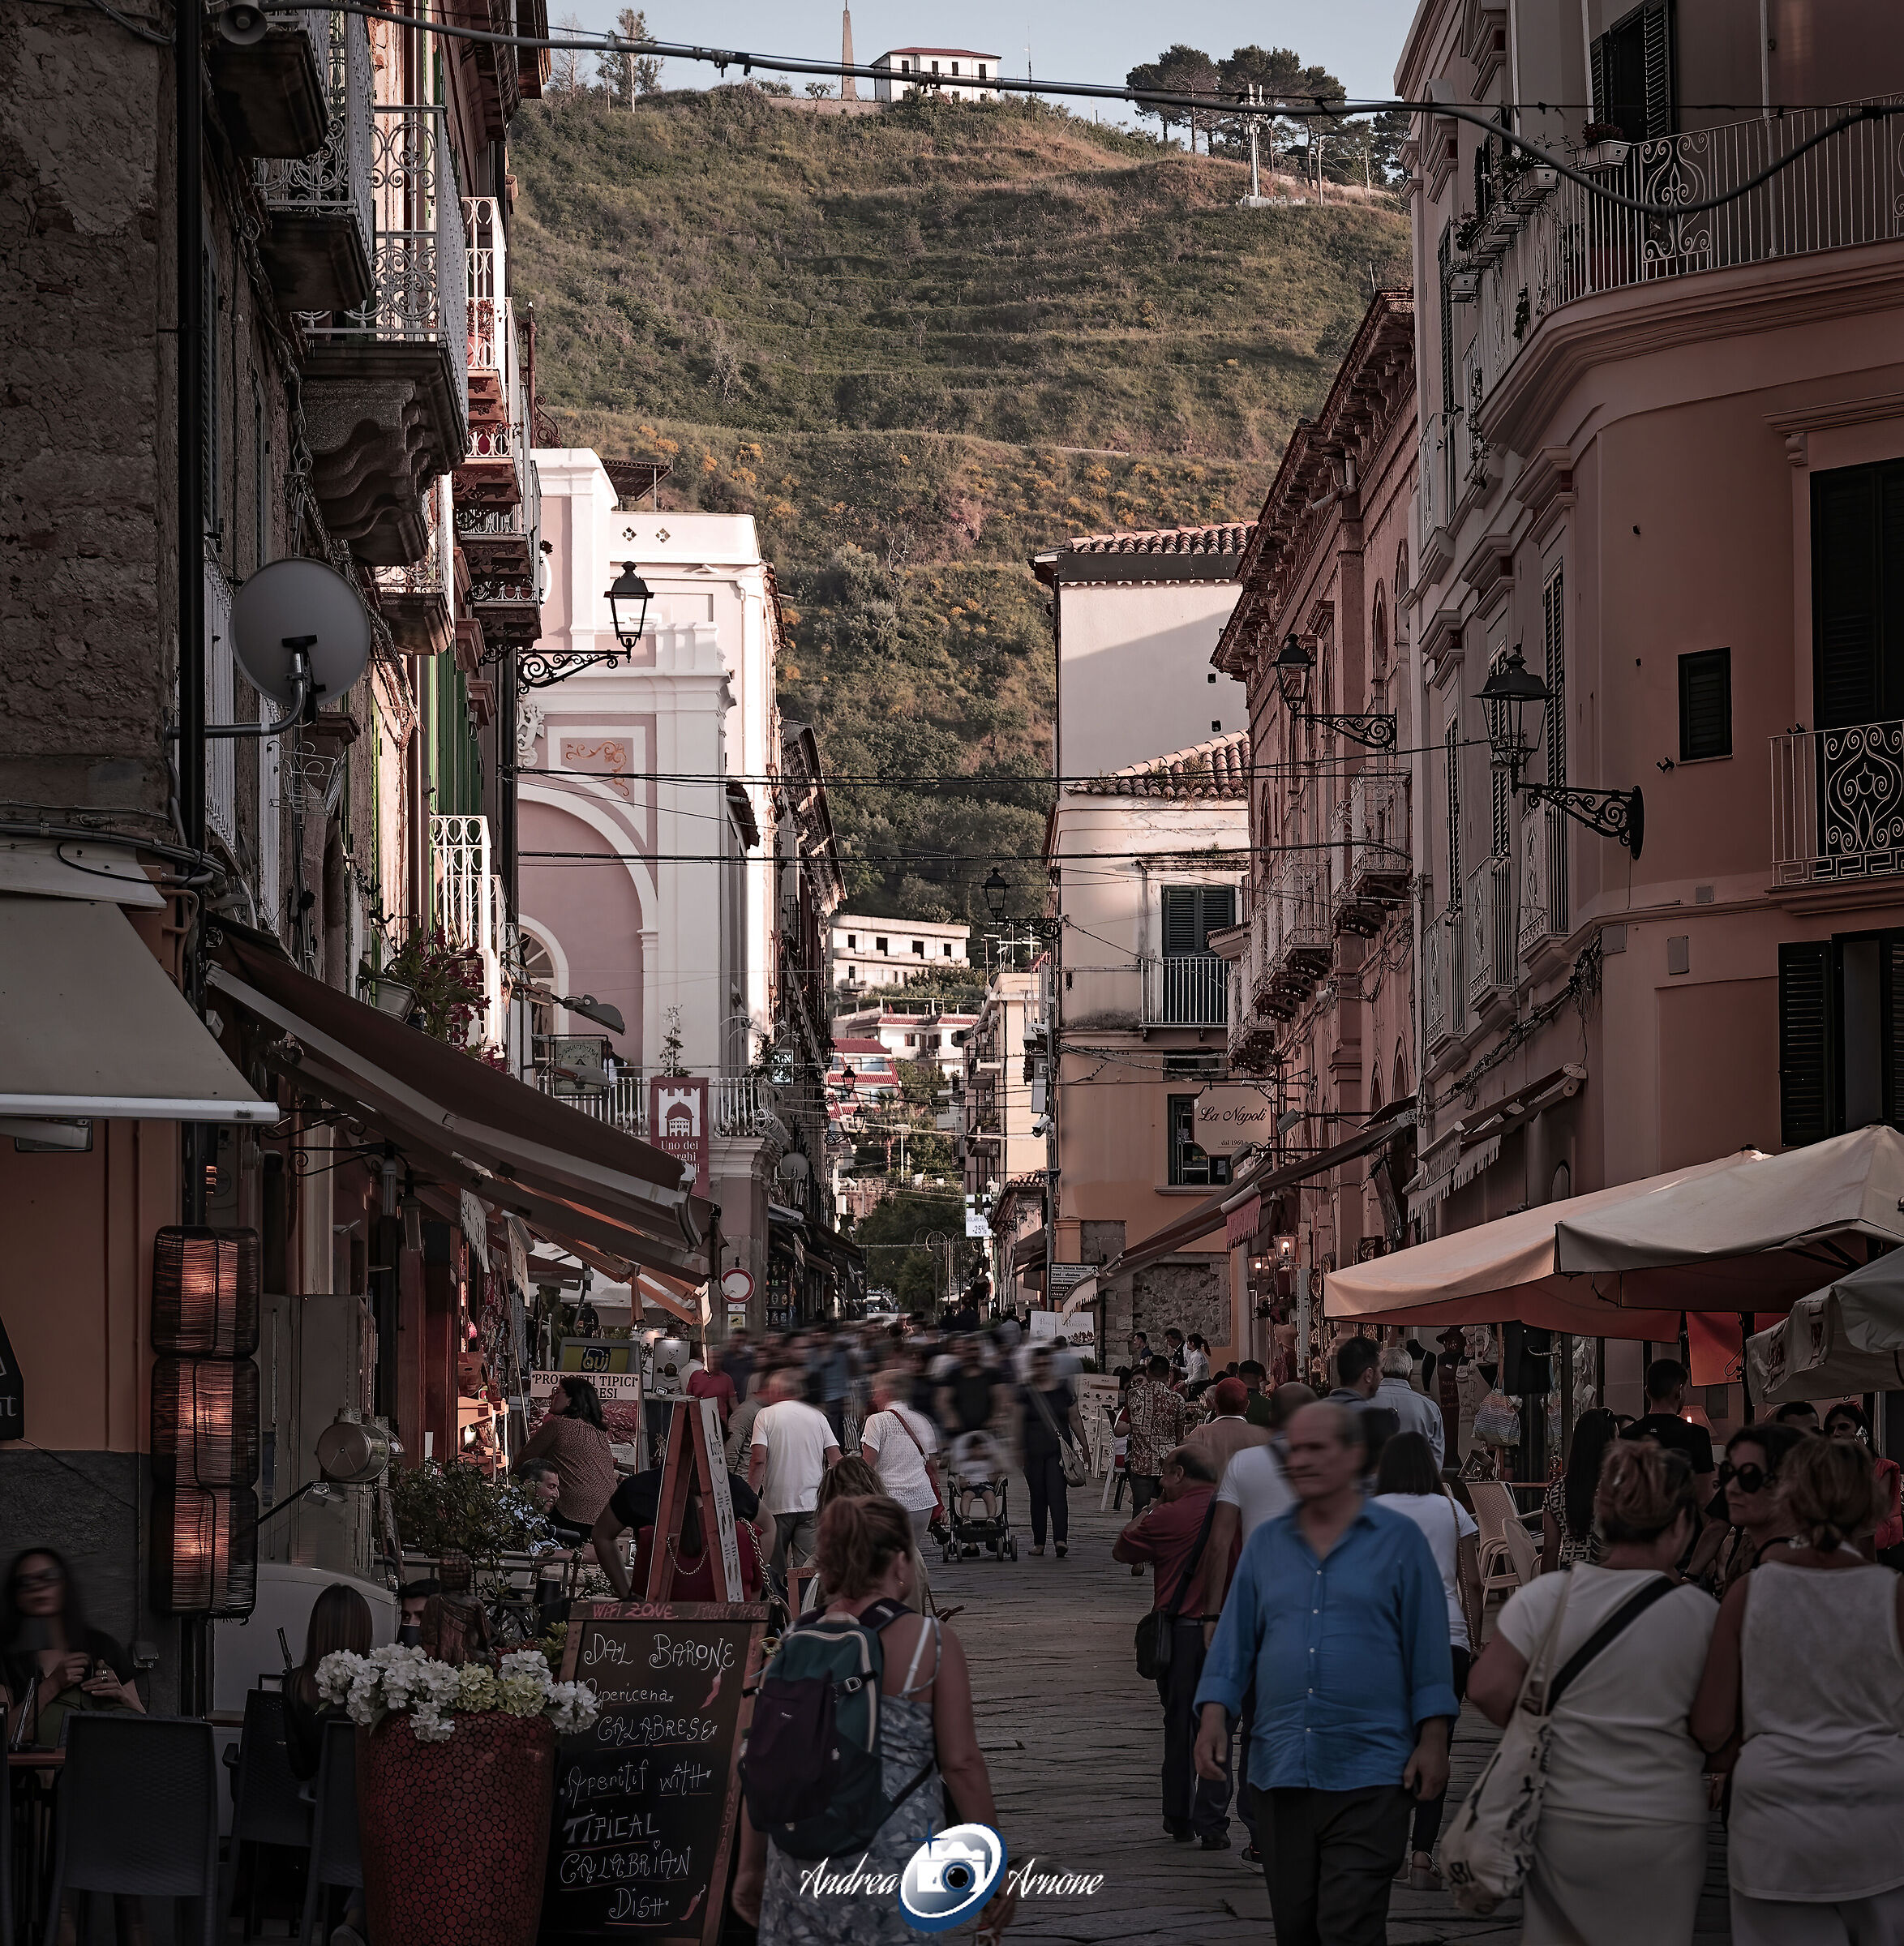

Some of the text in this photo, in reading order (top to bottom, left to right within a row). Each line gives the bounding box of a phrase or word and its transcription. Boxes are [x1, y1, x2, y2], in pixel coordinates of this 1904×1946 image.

[1198, 1106, 1267, 1125] La Napoli
[661, 1140, 698, 1150] Uno dei
[599, 1375, 635, 1387] TIPICI
[625, 1602, 678, 1619] ZONE
[585, 1633, 735, 1671] DAL BARONE
[598, 1714, 718, 1747] CALABRESE
